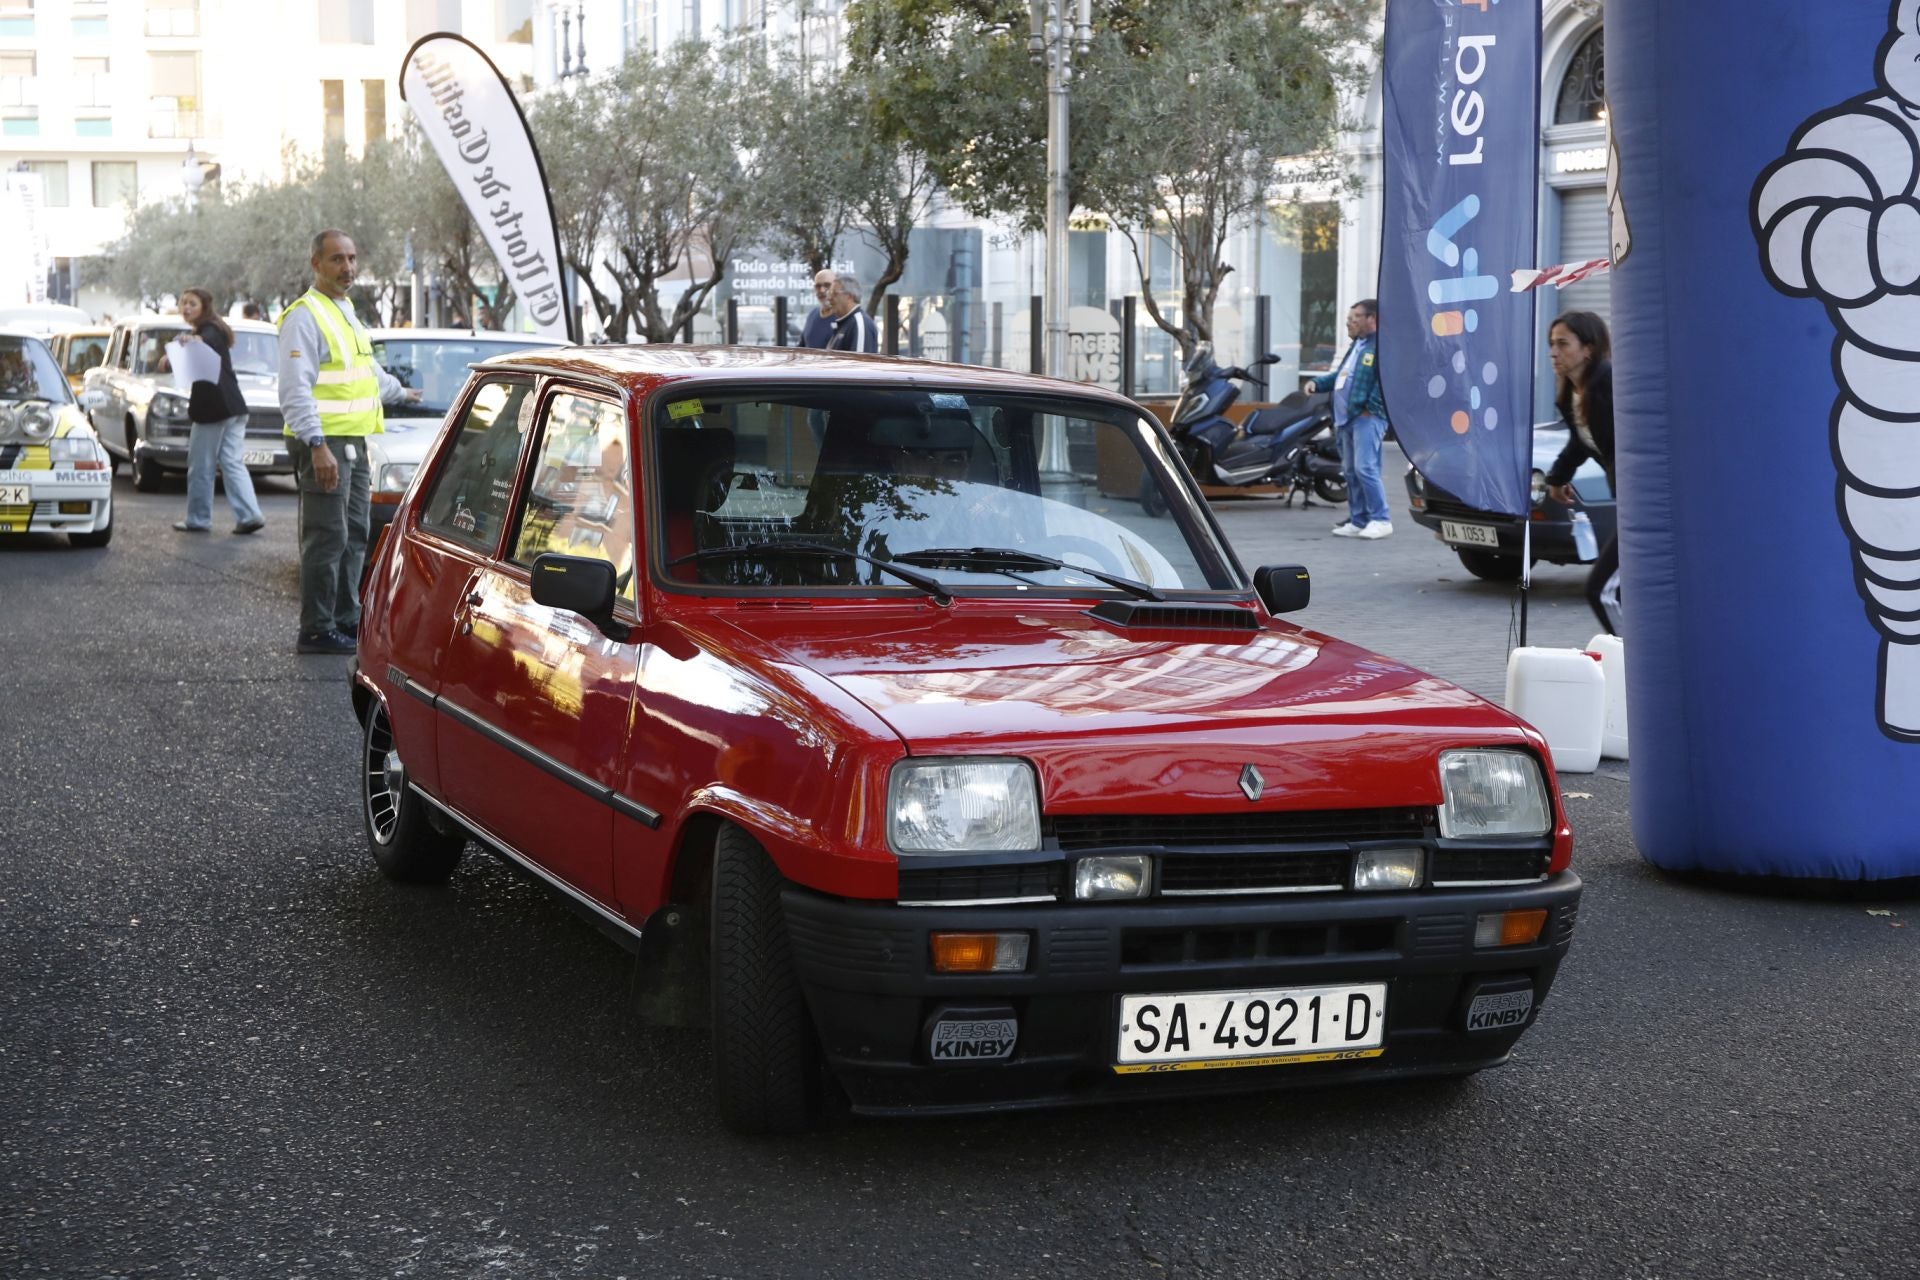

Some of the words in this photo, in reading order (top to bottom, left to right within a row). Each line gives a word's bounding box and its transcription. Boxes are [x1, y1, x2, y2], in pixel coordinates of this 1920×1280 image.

[732, 259, 768, 273] Todo
[770, 262, 787, 273] es
[823, 259, 855, 273] ácil
[732, 276, 785, 289] cuando
[787, 276, 815, 289] hab
[748, 292, 797, 305] miso
[800, 292, 820, 305] idi
[1069, 333, 1120, 353] RGER
[1068, 354, 1120, 382] ING
[1442, 522, 1458, 539] VA
[1462, 525, 1486, 542] 1053
[1490, 529, 1496, 543] J
[1469, 1007, 1530, 1028] KINBY
[934, 1039, 1014, 1057] KINBY
